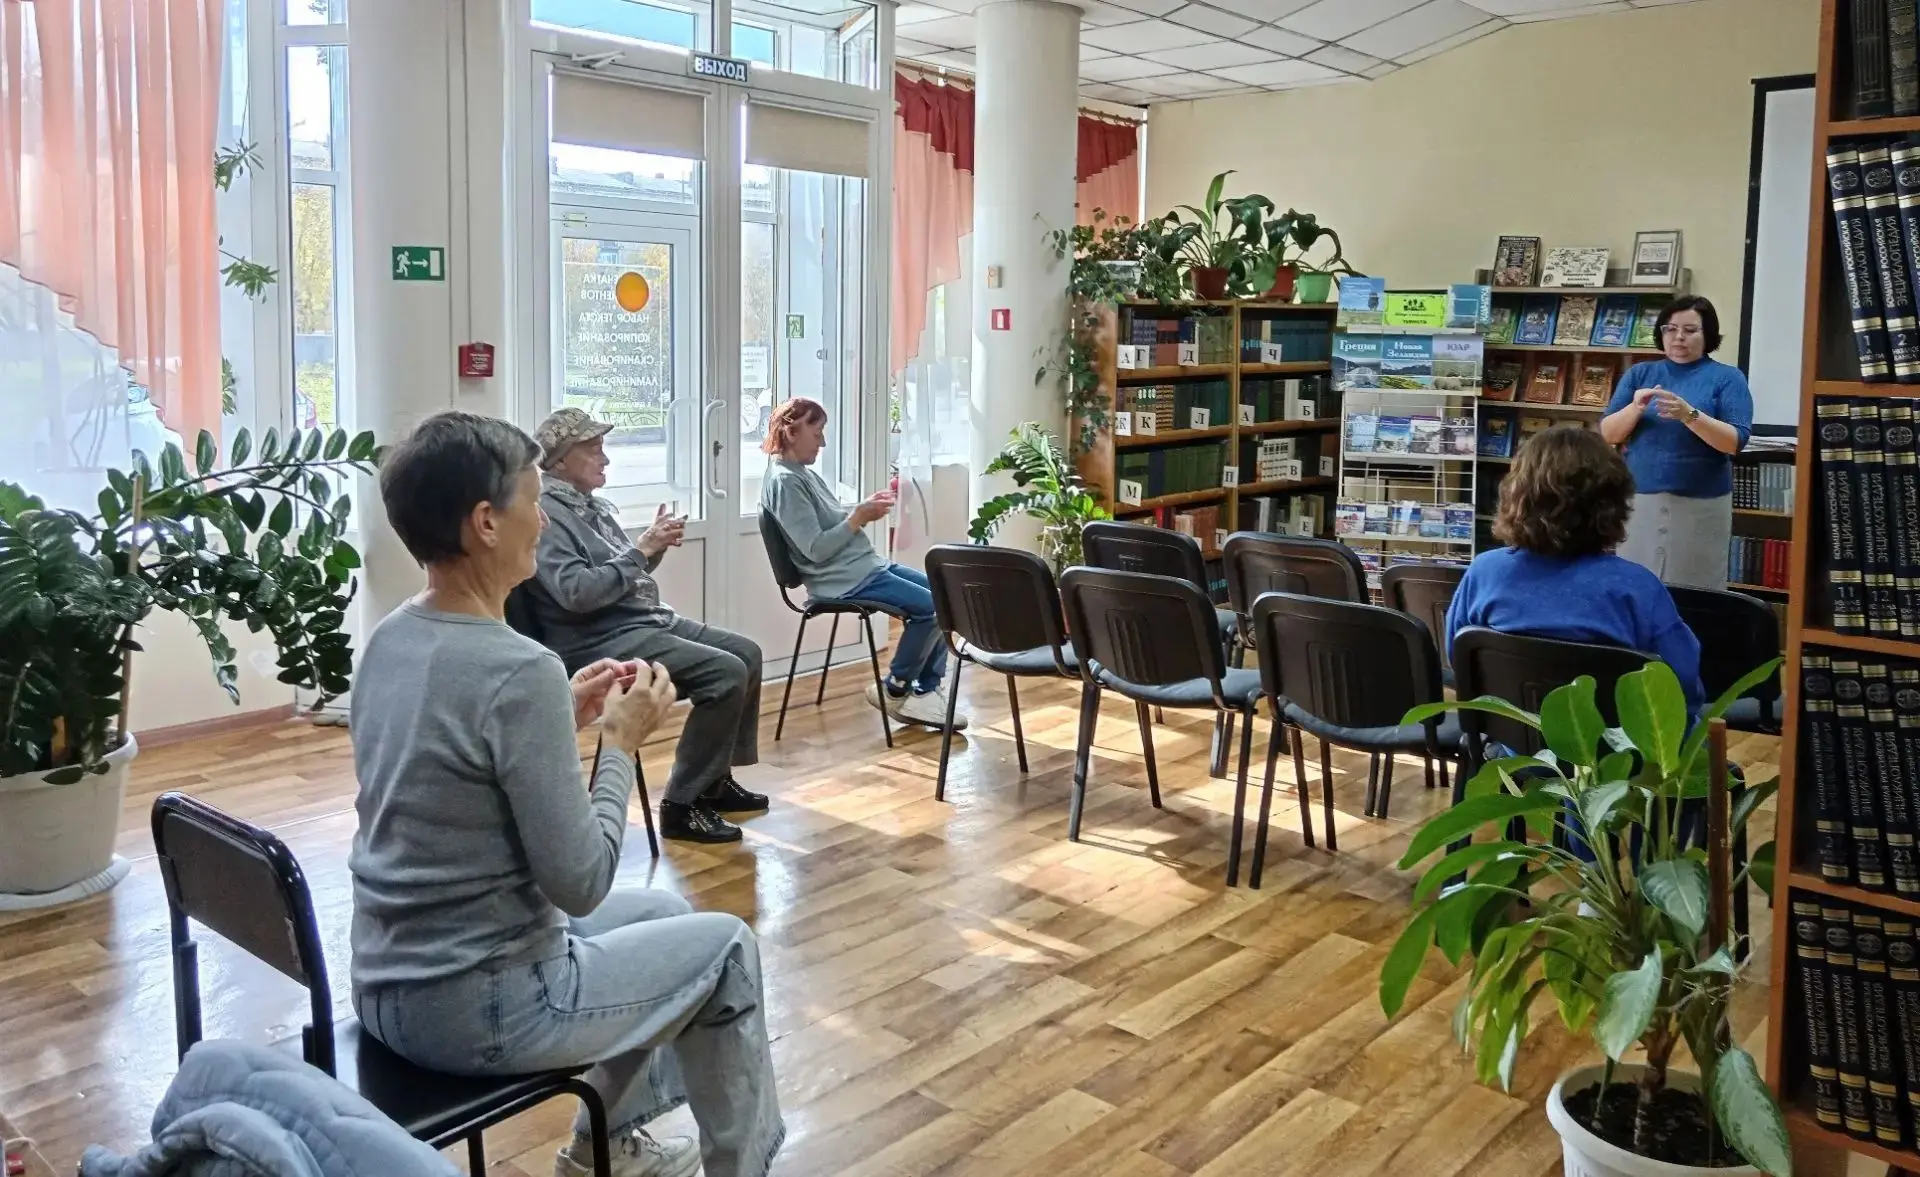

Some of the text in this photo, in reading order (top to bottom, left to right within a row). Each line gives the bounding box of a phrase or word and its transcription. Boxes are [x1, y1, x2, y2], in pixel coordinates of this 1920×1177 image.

[695, 56, 746, 82] ВЫХОД
[1851, 218, 1873, 307] ЭНЦИКЛОПЕДИЯ
[1886, 216, 1908, 306] ЭНЦИКЛОПЕДИЯ
[1848, 272, 1861, 309] БОЛЬШАЯ
[1882, 271, 1896, 309] БОЛЬШАЯ
[1339, 340, 1377, 352] Греция
[1394, 341, 1424, 350] Новая
[1135, 348, 1146, 361] Г
[1183, 350, 1195, 363] Д
[1386, 349, 1430, 359] Зеландия
[1302, 405, 1311, 416] Б
[1141, 416, 1151, 429] К
[1194, 412, 1205, 425] Л
[1225, 471, 1234, 483] П
[1290, 465, 1298, 476] В
[1126, 485, 1137, 499] М
